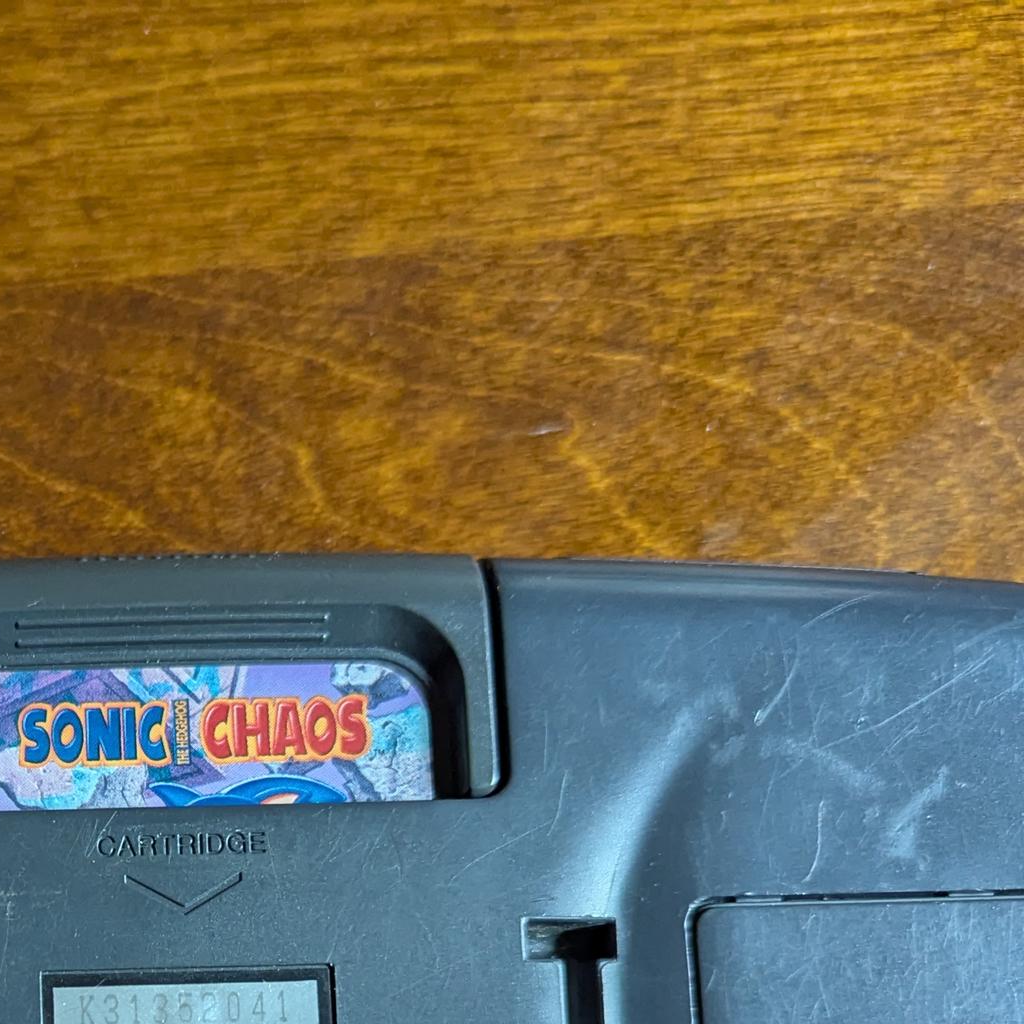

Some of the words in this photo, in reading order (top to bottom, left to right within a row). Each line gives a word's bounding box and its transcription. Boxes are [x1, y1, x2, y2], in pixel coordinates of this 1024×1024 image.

[19, 702, 170, 768] SONIC
[202, 698, 370, 762] CHAOS
[97, 831, 266, 857] CARTRIDGE
